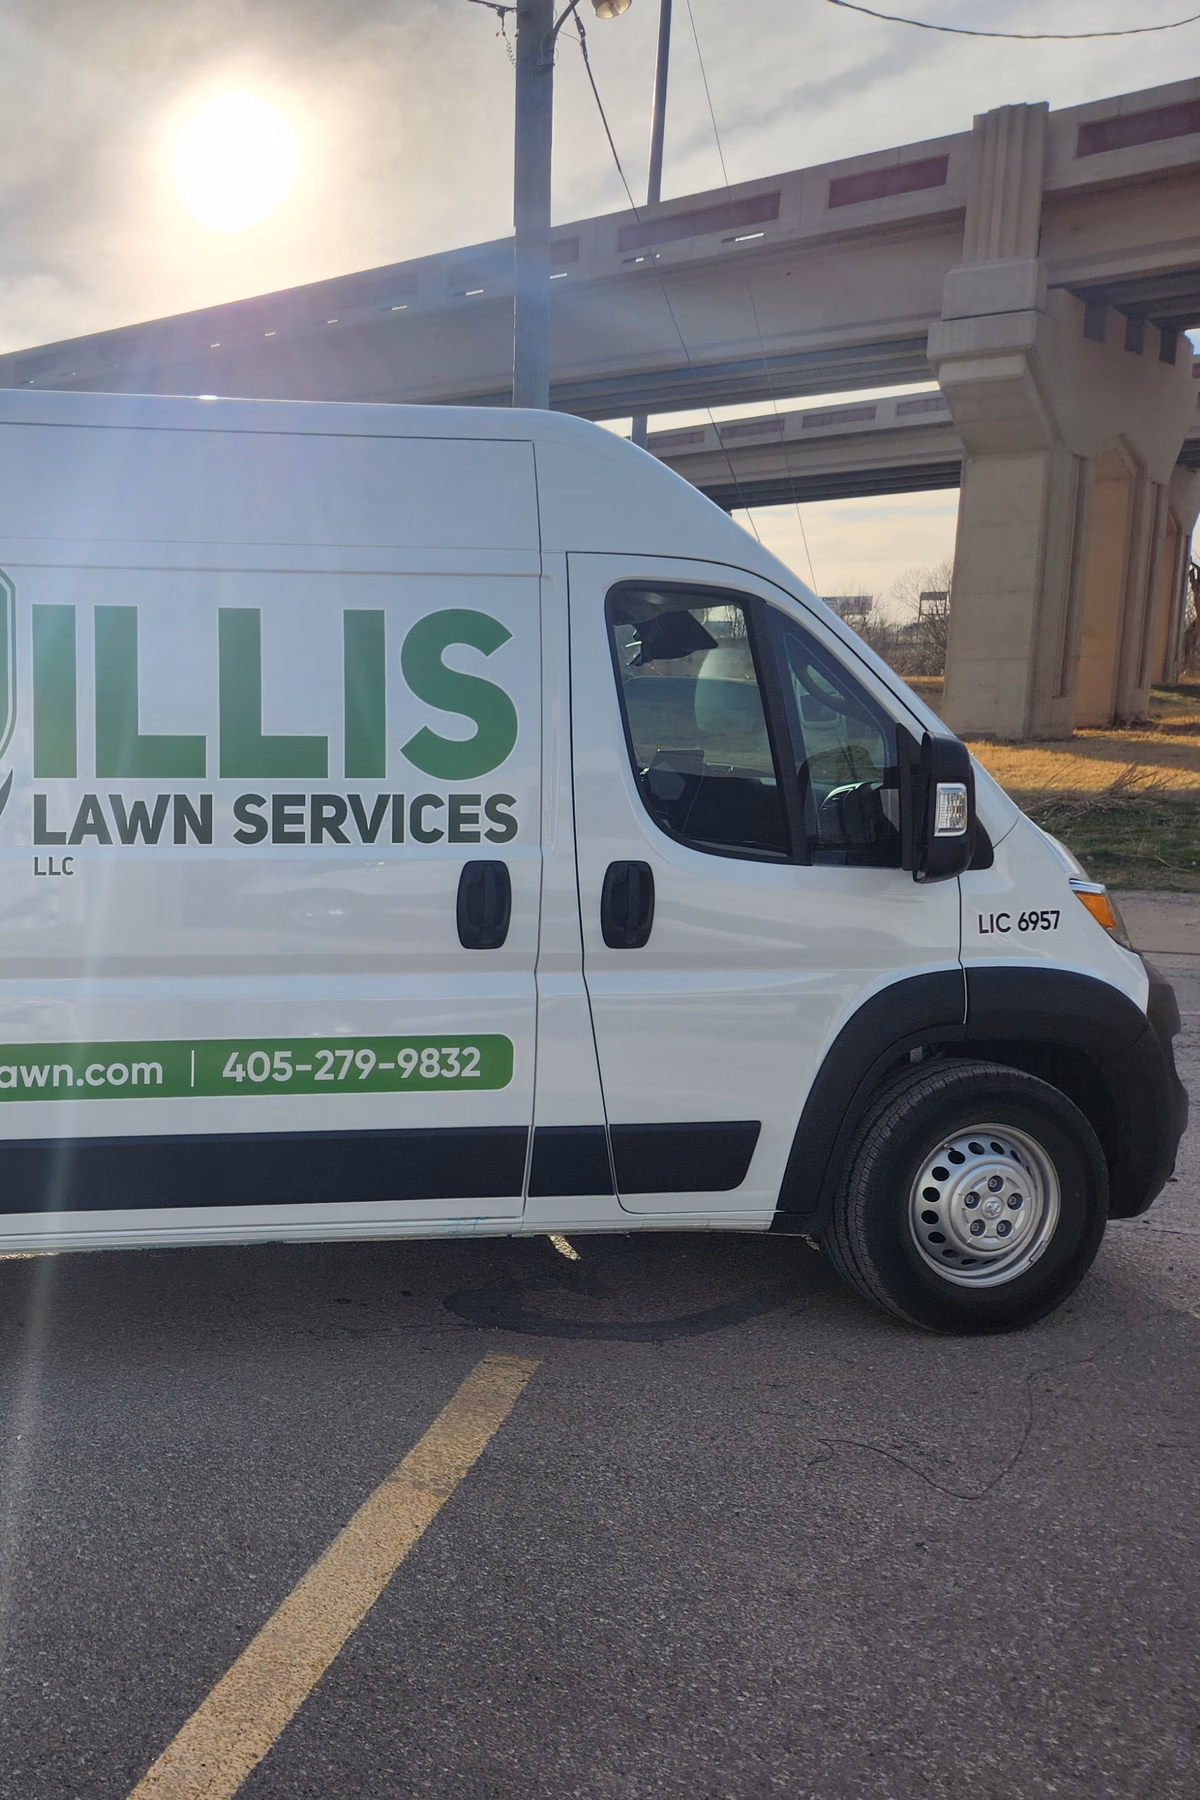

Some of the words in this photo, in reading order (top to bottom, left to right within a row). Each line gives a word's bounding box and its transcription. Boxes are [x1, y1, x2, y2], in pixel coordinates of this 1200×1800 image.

[33, 794, 213, 845] LAWN
[233, 793, 518, 844] SERVICES
[34, 856, 75, 876] LLC
[978, 912, 1012, 934] LIC
[1017, 910, 1060, 931] 6957
[222, 1046, 481, 1083] 405-279-9832
